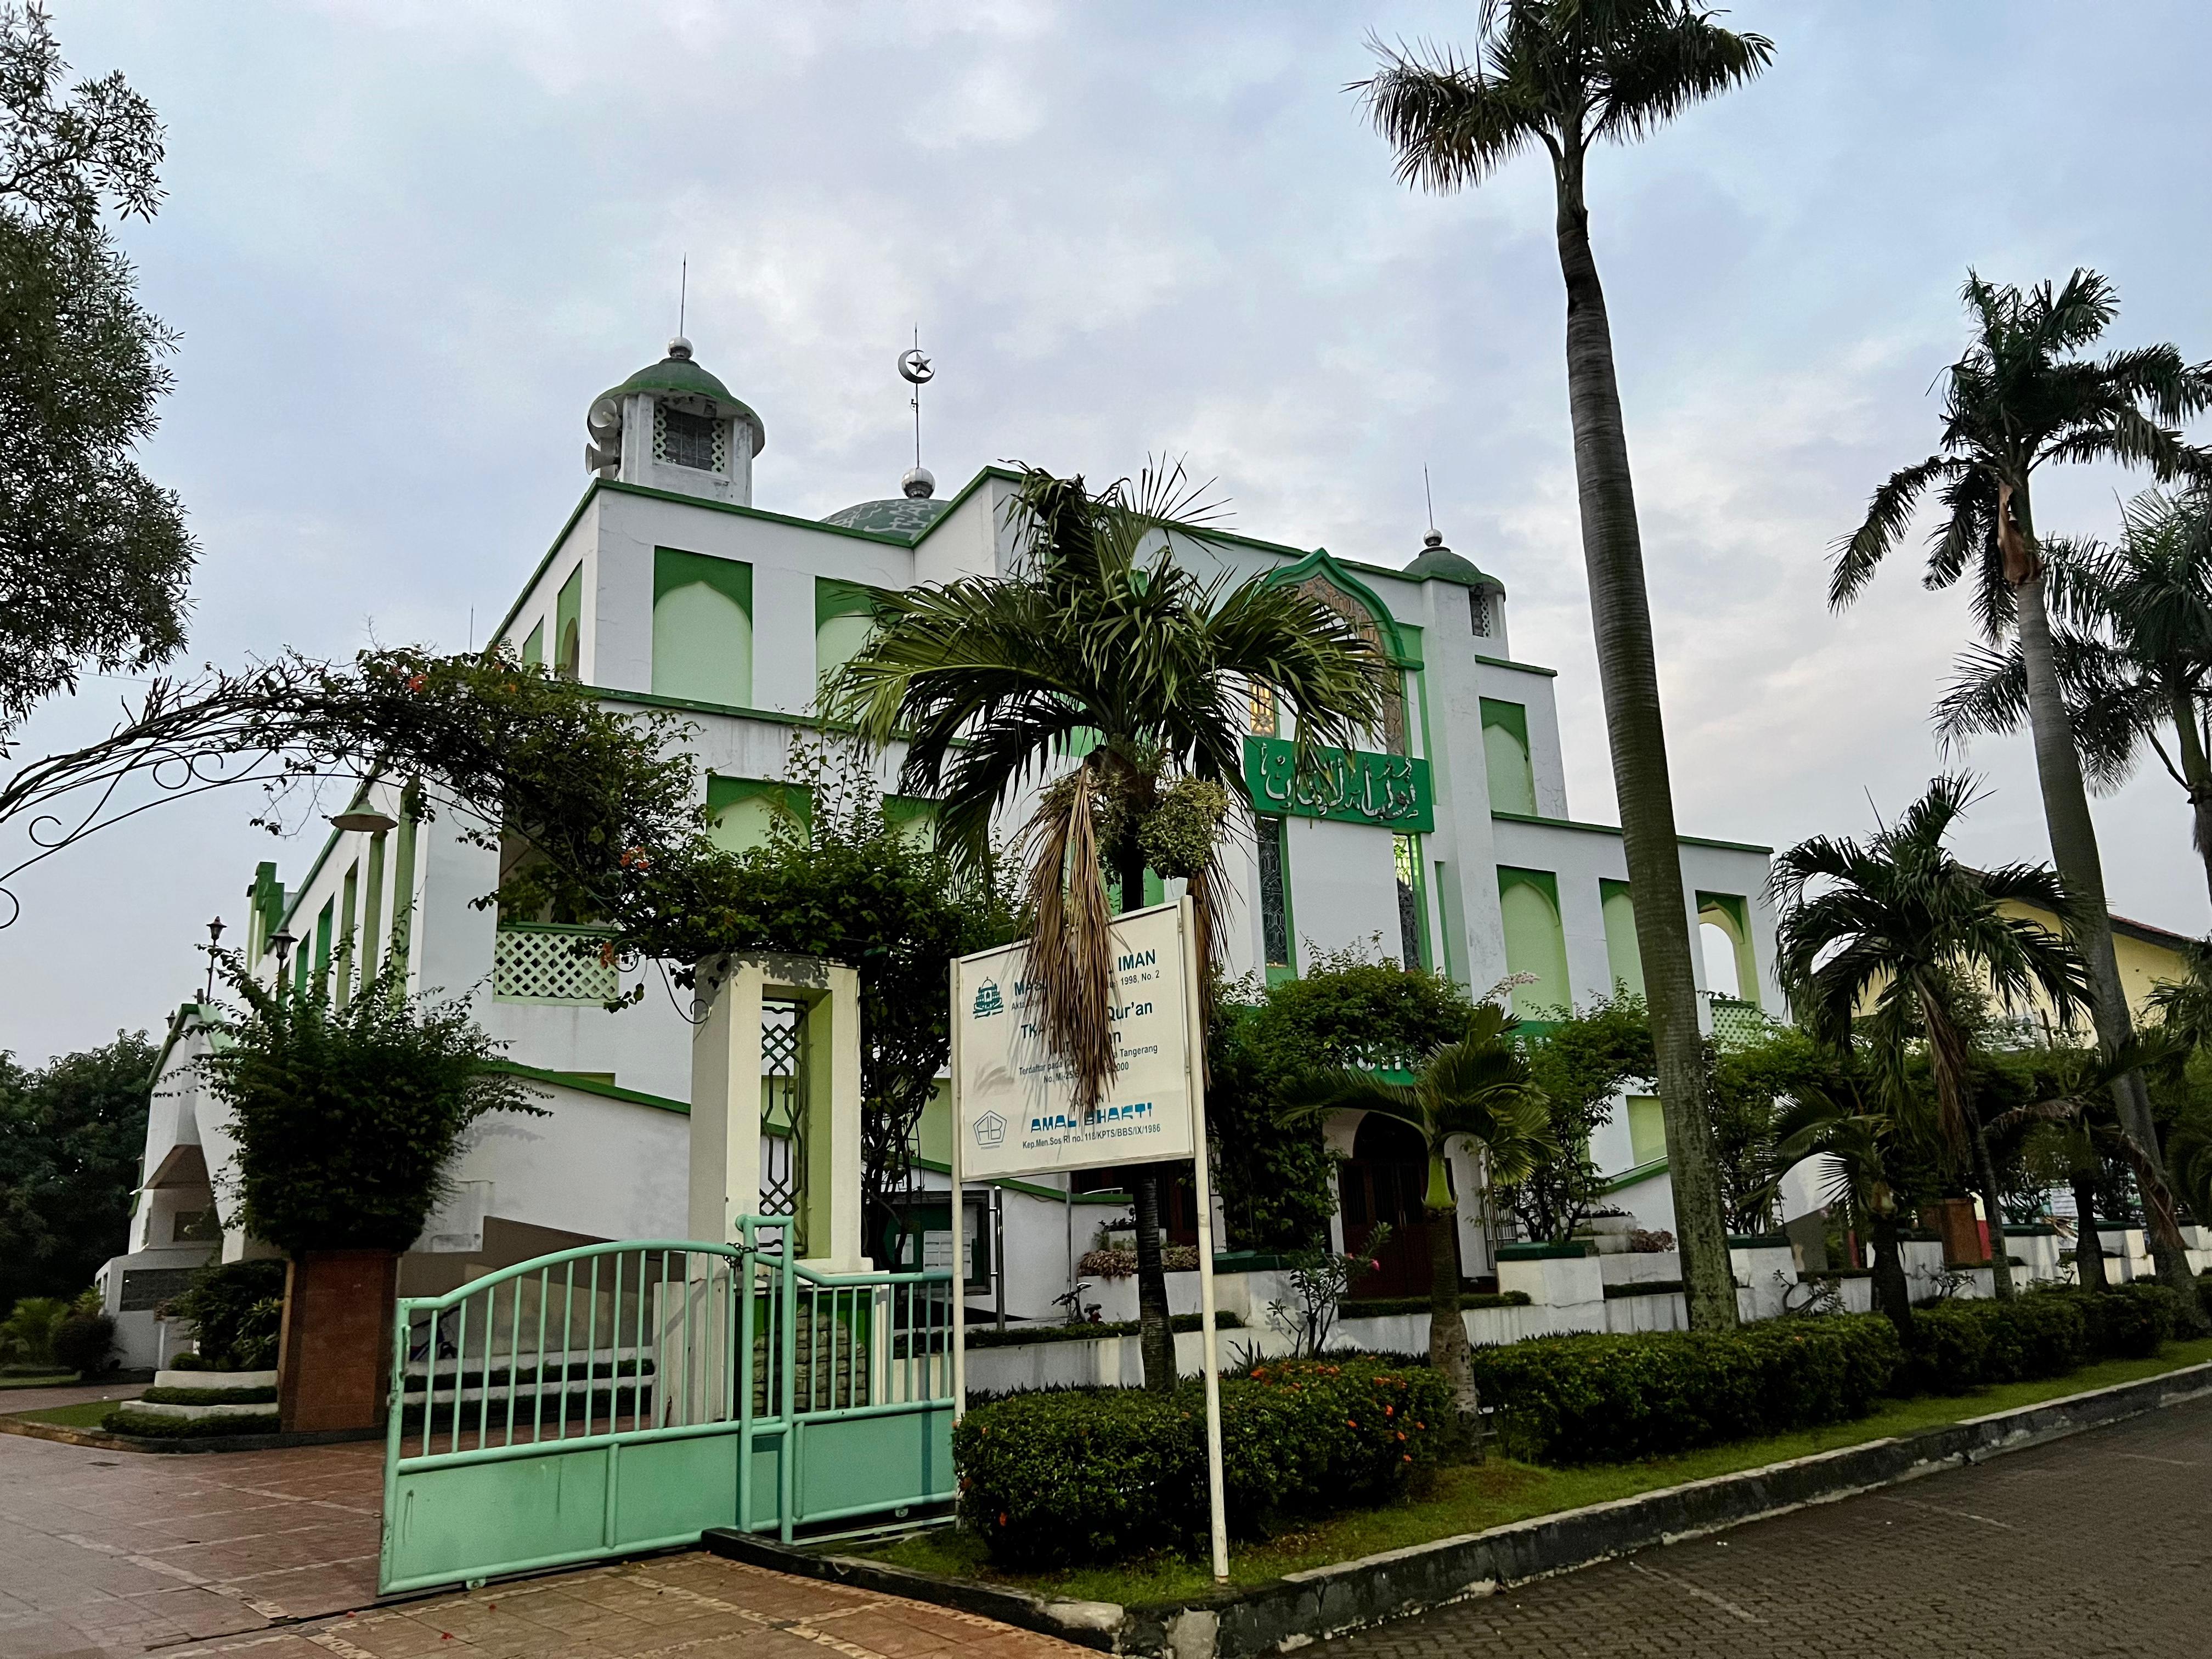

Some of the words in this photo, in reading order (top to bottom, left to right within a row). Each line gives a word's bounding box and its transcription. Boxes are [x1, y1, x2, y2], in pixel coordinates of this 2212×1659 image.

[1118, 949, 1155, 972] IMAN
[1121, 974, 1139, 986] 1998,
[1142, 973, 1154, 982] No.
[1155, 969, 1160, 979] 2
[1047, 1060, 1063, 1072] pada
[1120, 1045, 1158, 1058] Tangerang
[1043, 1075, 1054, 1084] No.
[1031, 1113, 1077, 1133] AMAL
[1084, 1102, 1152, 1126] BHAKTI
[1023, 1136, 1062, 1150] Kep.Men.Sos
[1063, 1134, 1070, 1144] RI
